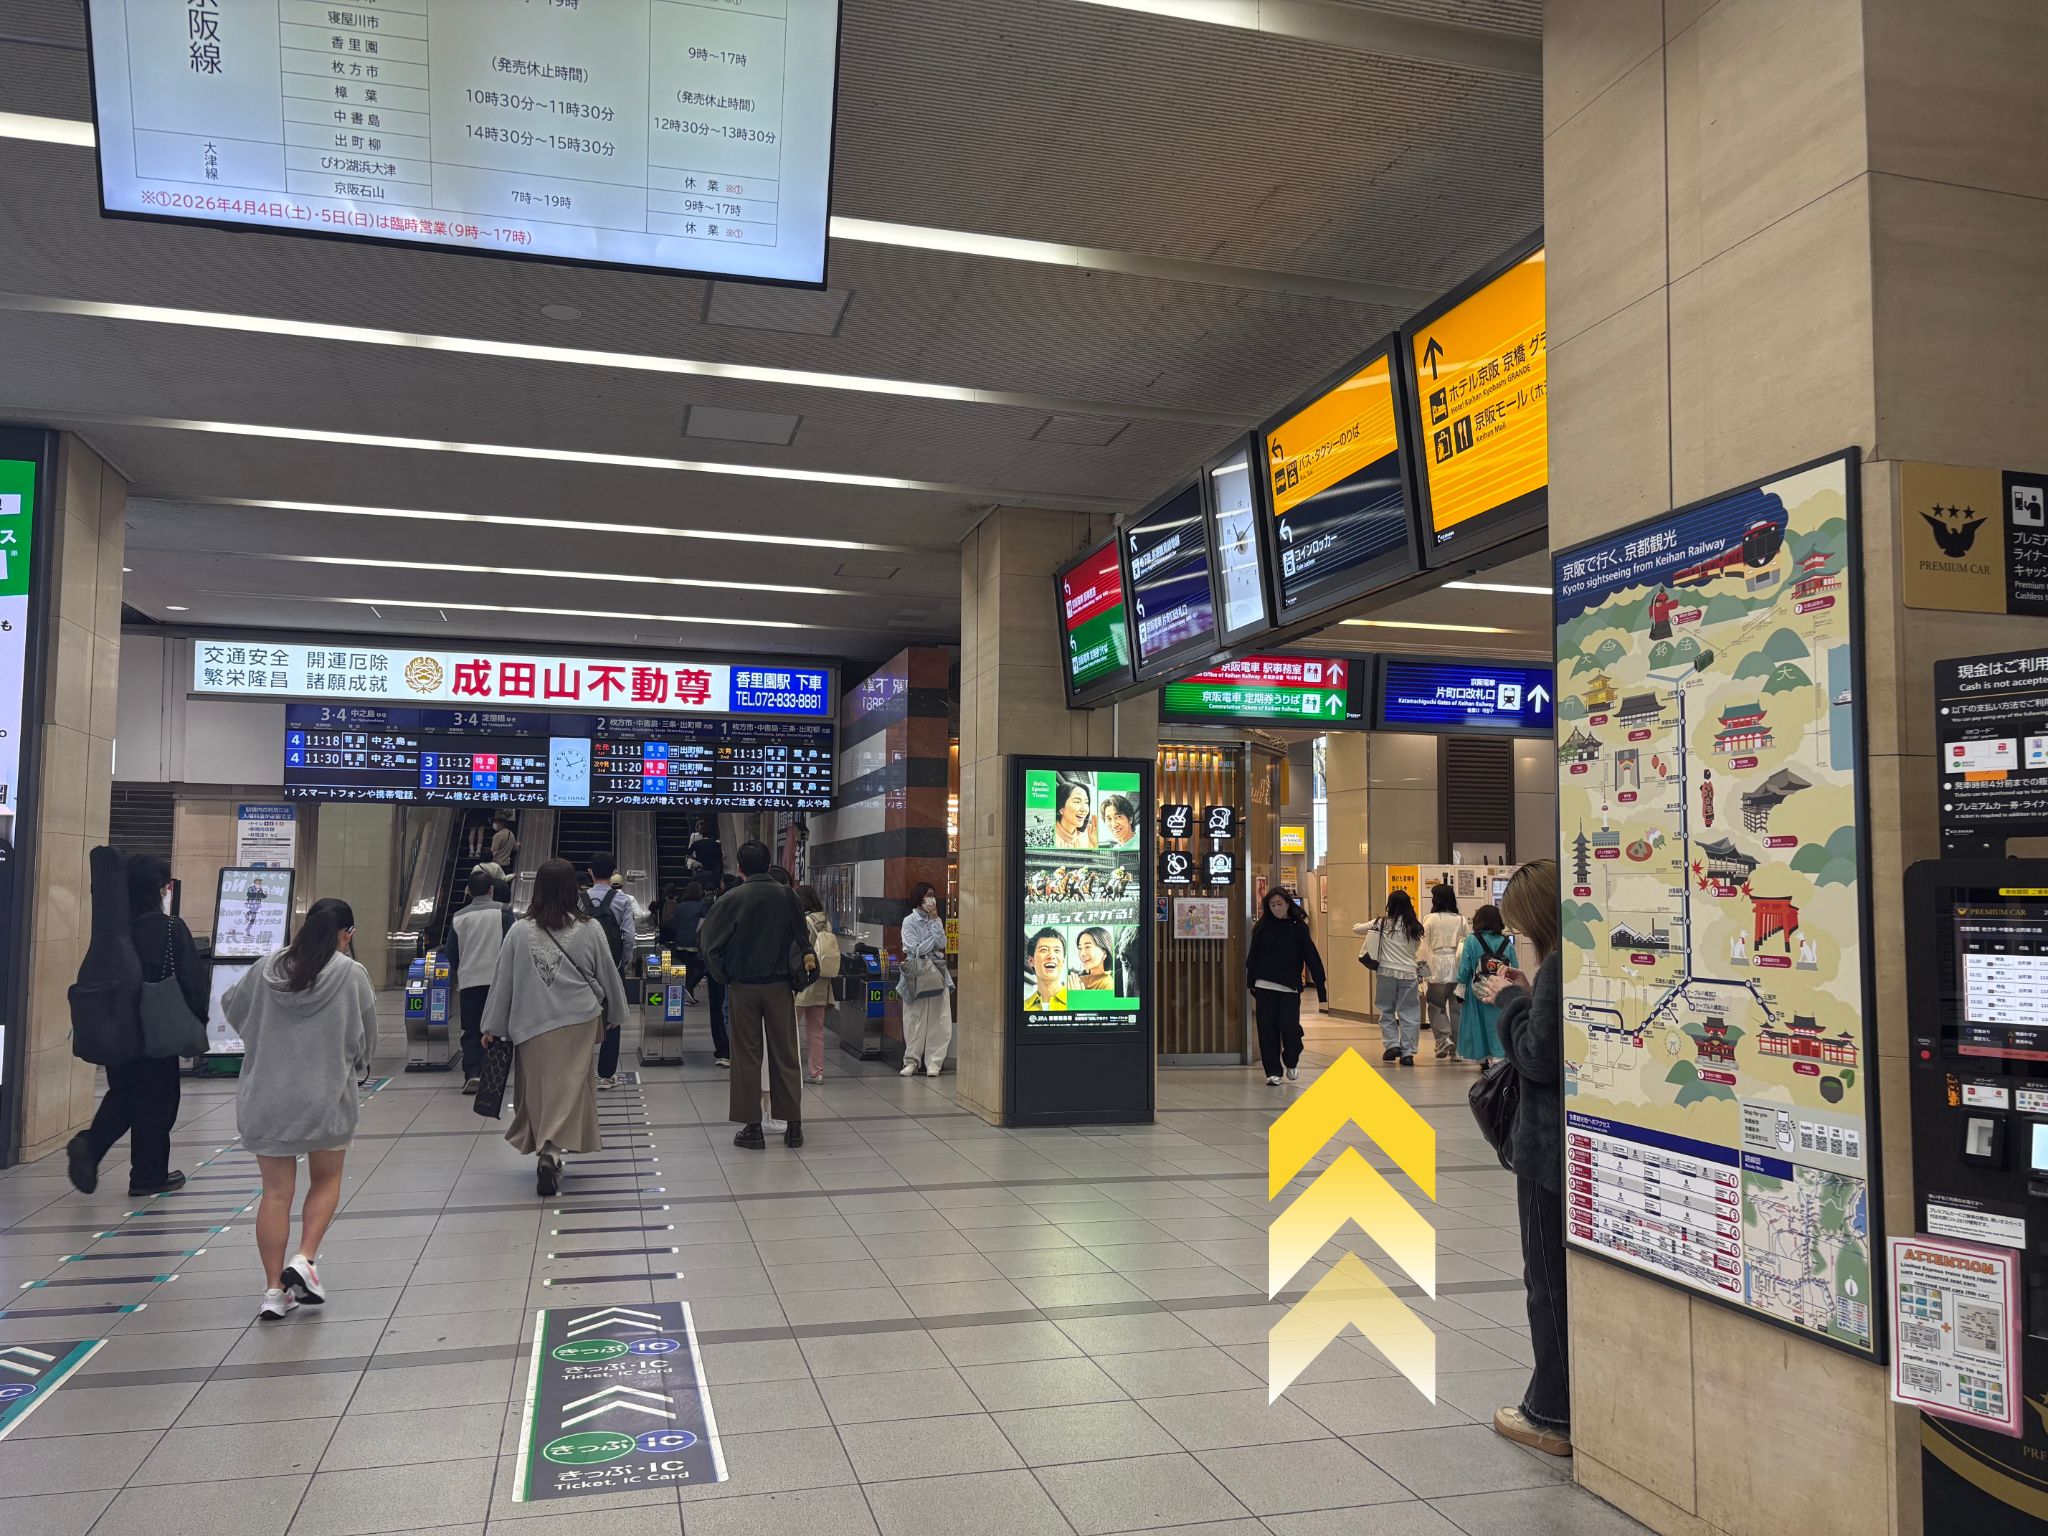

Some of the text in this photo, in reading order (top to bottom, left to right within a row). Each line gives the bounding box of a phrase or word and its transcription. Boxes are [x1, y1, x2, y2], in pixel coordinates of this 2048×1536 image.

[327, 11, 380, 30] 寝屋川市
[331, 36, 379, 54] 香里園
[331, 60, 379, 79] 枚方市
[491, 56, 589, 84] (発売休止時間)
[676, 89, 756, 113] (発売休止時間)
[334, 109, 381, 128] 中書島
[335, 134, 382, 152] 出町柳
[203, 141, 219, 181] 大津線
[320, 156, 396, 177] びわ湖浜大津
[334, 181, 385, 200] 京阪石山
[1449, 343, 1526, 403] ホテル京阪 京橋
[1507, 363, 1531, 383] GRANDE
[1474, 389, 1528, 431] 京阪モール
[1299, 422, 1360, 472] バス・タクシーのりば
[1294, 534, 1338, 562] コインロッカー
[1562, 528, 1678, 582] 京阪で行く、京都観光
[1562, 537, 1726, 596] Kyoto sightseeing from Keihan Railway
[1919, 560, 1991, 575] PREMIUM CAR
[2014, 580, 2046, 590] Premium
[2015, 591, 2044, 601] Cashless
[1656, 644, 1668, 657] 妙
[1681, 638, 1692, 651] 法
[204, 646, 389, 672] 交通安全 開運厄除
[1221, 661, 1302, 675] 京阪電車 駅事務室
[1776, 665, 1796, 681] 大
[203, 667, 389, 693] 繁栄隆昌 諸願成就
[452, 657, 713, 705] 成田山不動尊
[735, 670, 823, 691] 香里園駅 下車
[1241, 673, 1260, 681] Railway
[1435, 686, 1496, 701] 片町口改札口
[1959, 681, 1982, 692] Cash
[1983, 681, 1992, 689] is
[1993, 680, 2010, 688] not
[735, 690, 822, 709] TEL.072-833-8881
[1202, 691, 1300, 706] 京阪電車 定期券うりば
[1475, 700, 1494, 709] Railway
[1281, 705, 1300, 713] Railway
[596, 717, 606, 730] 2
[720, 722, 728, 735] 1
[291, 734, 301, 746] 4
[305, 735, 340, 746] 11:18
[611, 744, 642, 755] 11:11
[733, 748, 763, 759] 11:13
[290, 753, 300, 764] 4
[305, 753, 340, 764] 11:30
[425, 756, 433, 767] 3
[438, 757, 471, 768] 11:12
[611, 762, 642, 773] 11:20
[733, 765, 763, 776] 11:24
[425, 774, 433, 785] 3
[438, 774, 470, 785] 11:21
[610, 778, 642, 790] 11:22
[732, 781, 762, 792] 11:36
[1970, 908, 2027, 917] PREMIUM CAR
[870, 990, 881, 1001] IC
[410, 998, 422, 1010] IC
[1900, 1262, 1921, 1270] Limited
[1922, 1266, 1944, 1274] Express
[1903, 1248, 1994, 1275] ATTENTION
[1924, 1273, 1949, 1282] reserved
[1949, 1277, 1962, 1285] seat
[558, 1342, 669, 1357] きっぷ IC
[561, 1372, 613, 1380] Ticket,
[637, 1367, 673, 1375] Card
[550, 1435, 685, 1456] きっぷ IC
[553, 1471, 689, 1491] Ticket, IC Card
